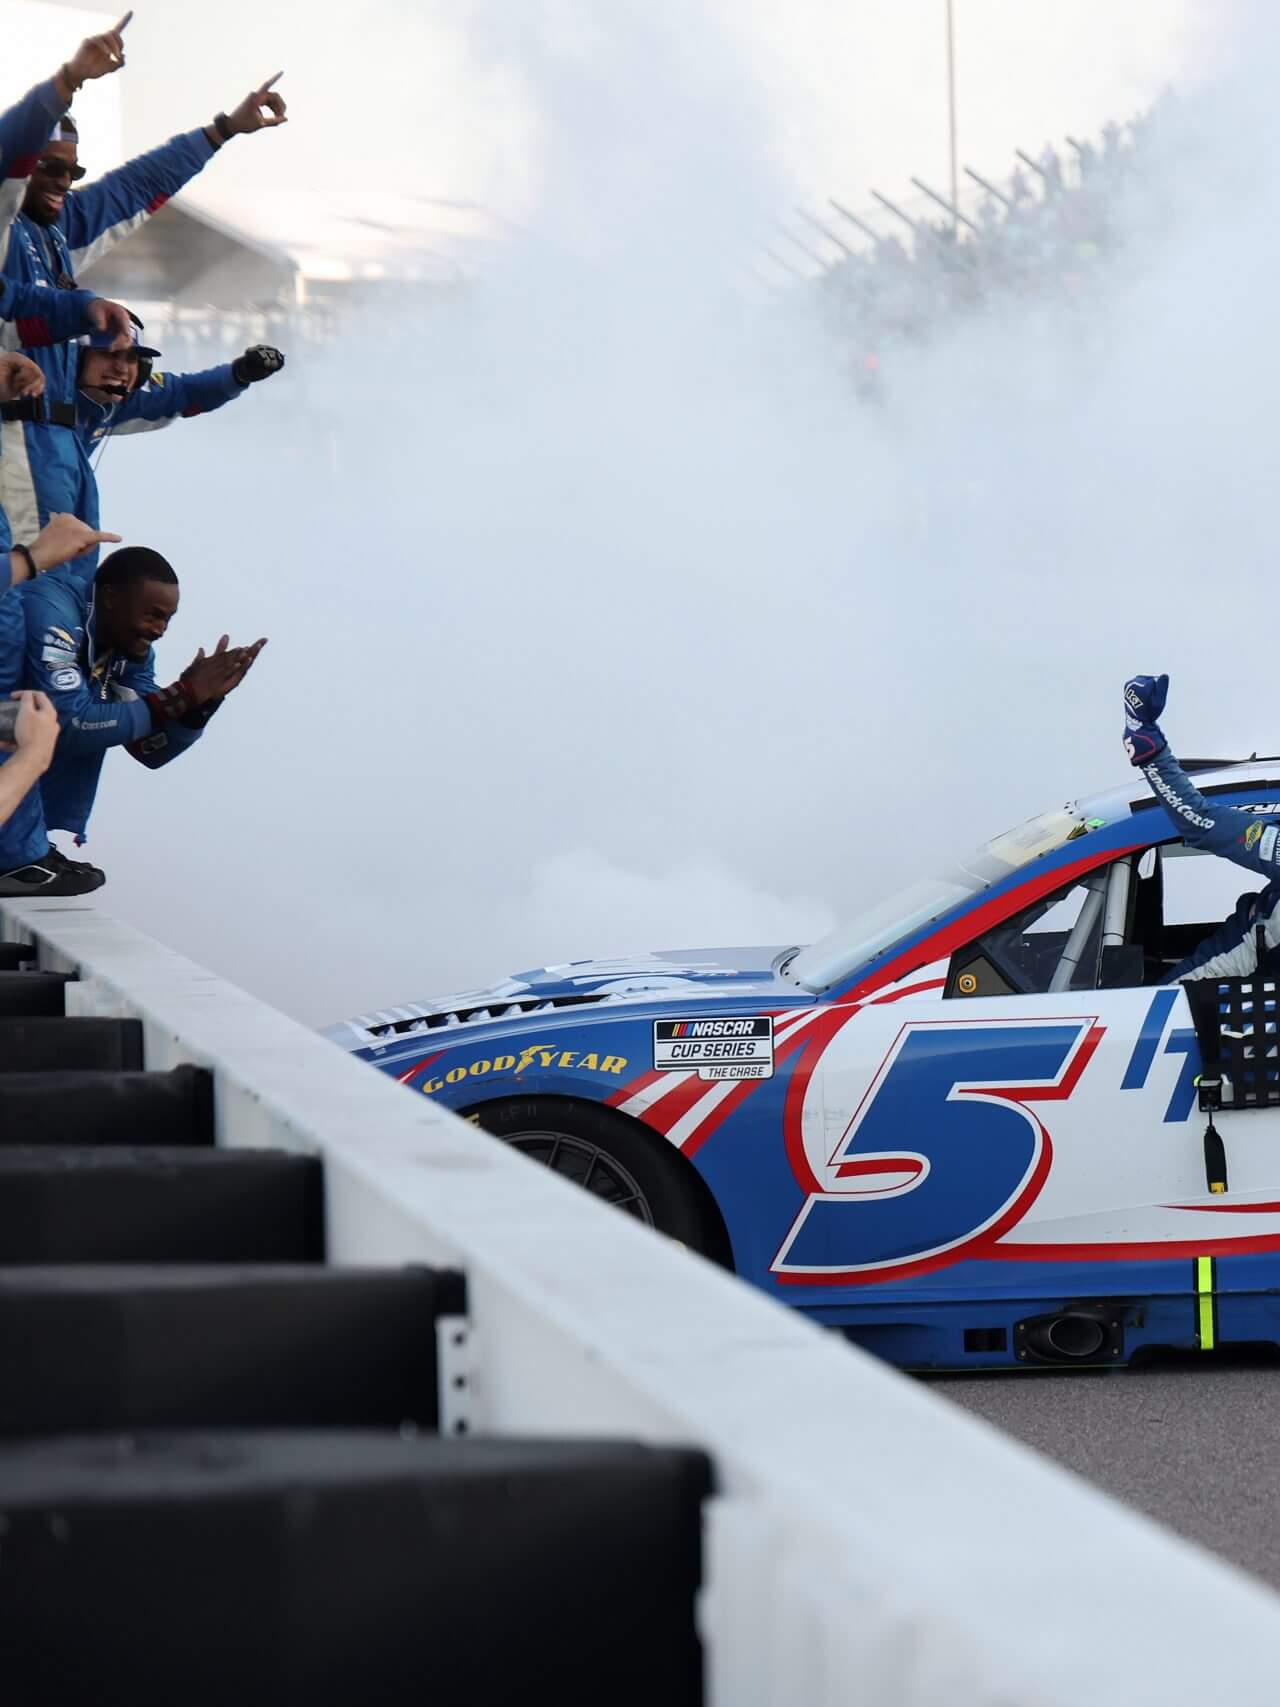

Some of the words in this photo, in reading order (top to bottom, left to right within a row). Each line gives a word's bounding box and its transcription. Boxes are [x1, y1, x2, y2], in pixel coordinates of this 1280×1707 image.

[690, 1021, 754, 1037] NASCAR
[671, 1044, 701, 1058] CUP
[705, 1042, 757, 1057] SERIES
[422, 1044, 630, 1095] GOODYEAR
[708, 1067, 727, 1079] THE
[729, 1066, 764, 1078] CHASE
[770, 1016, 1105, 1278] 5
